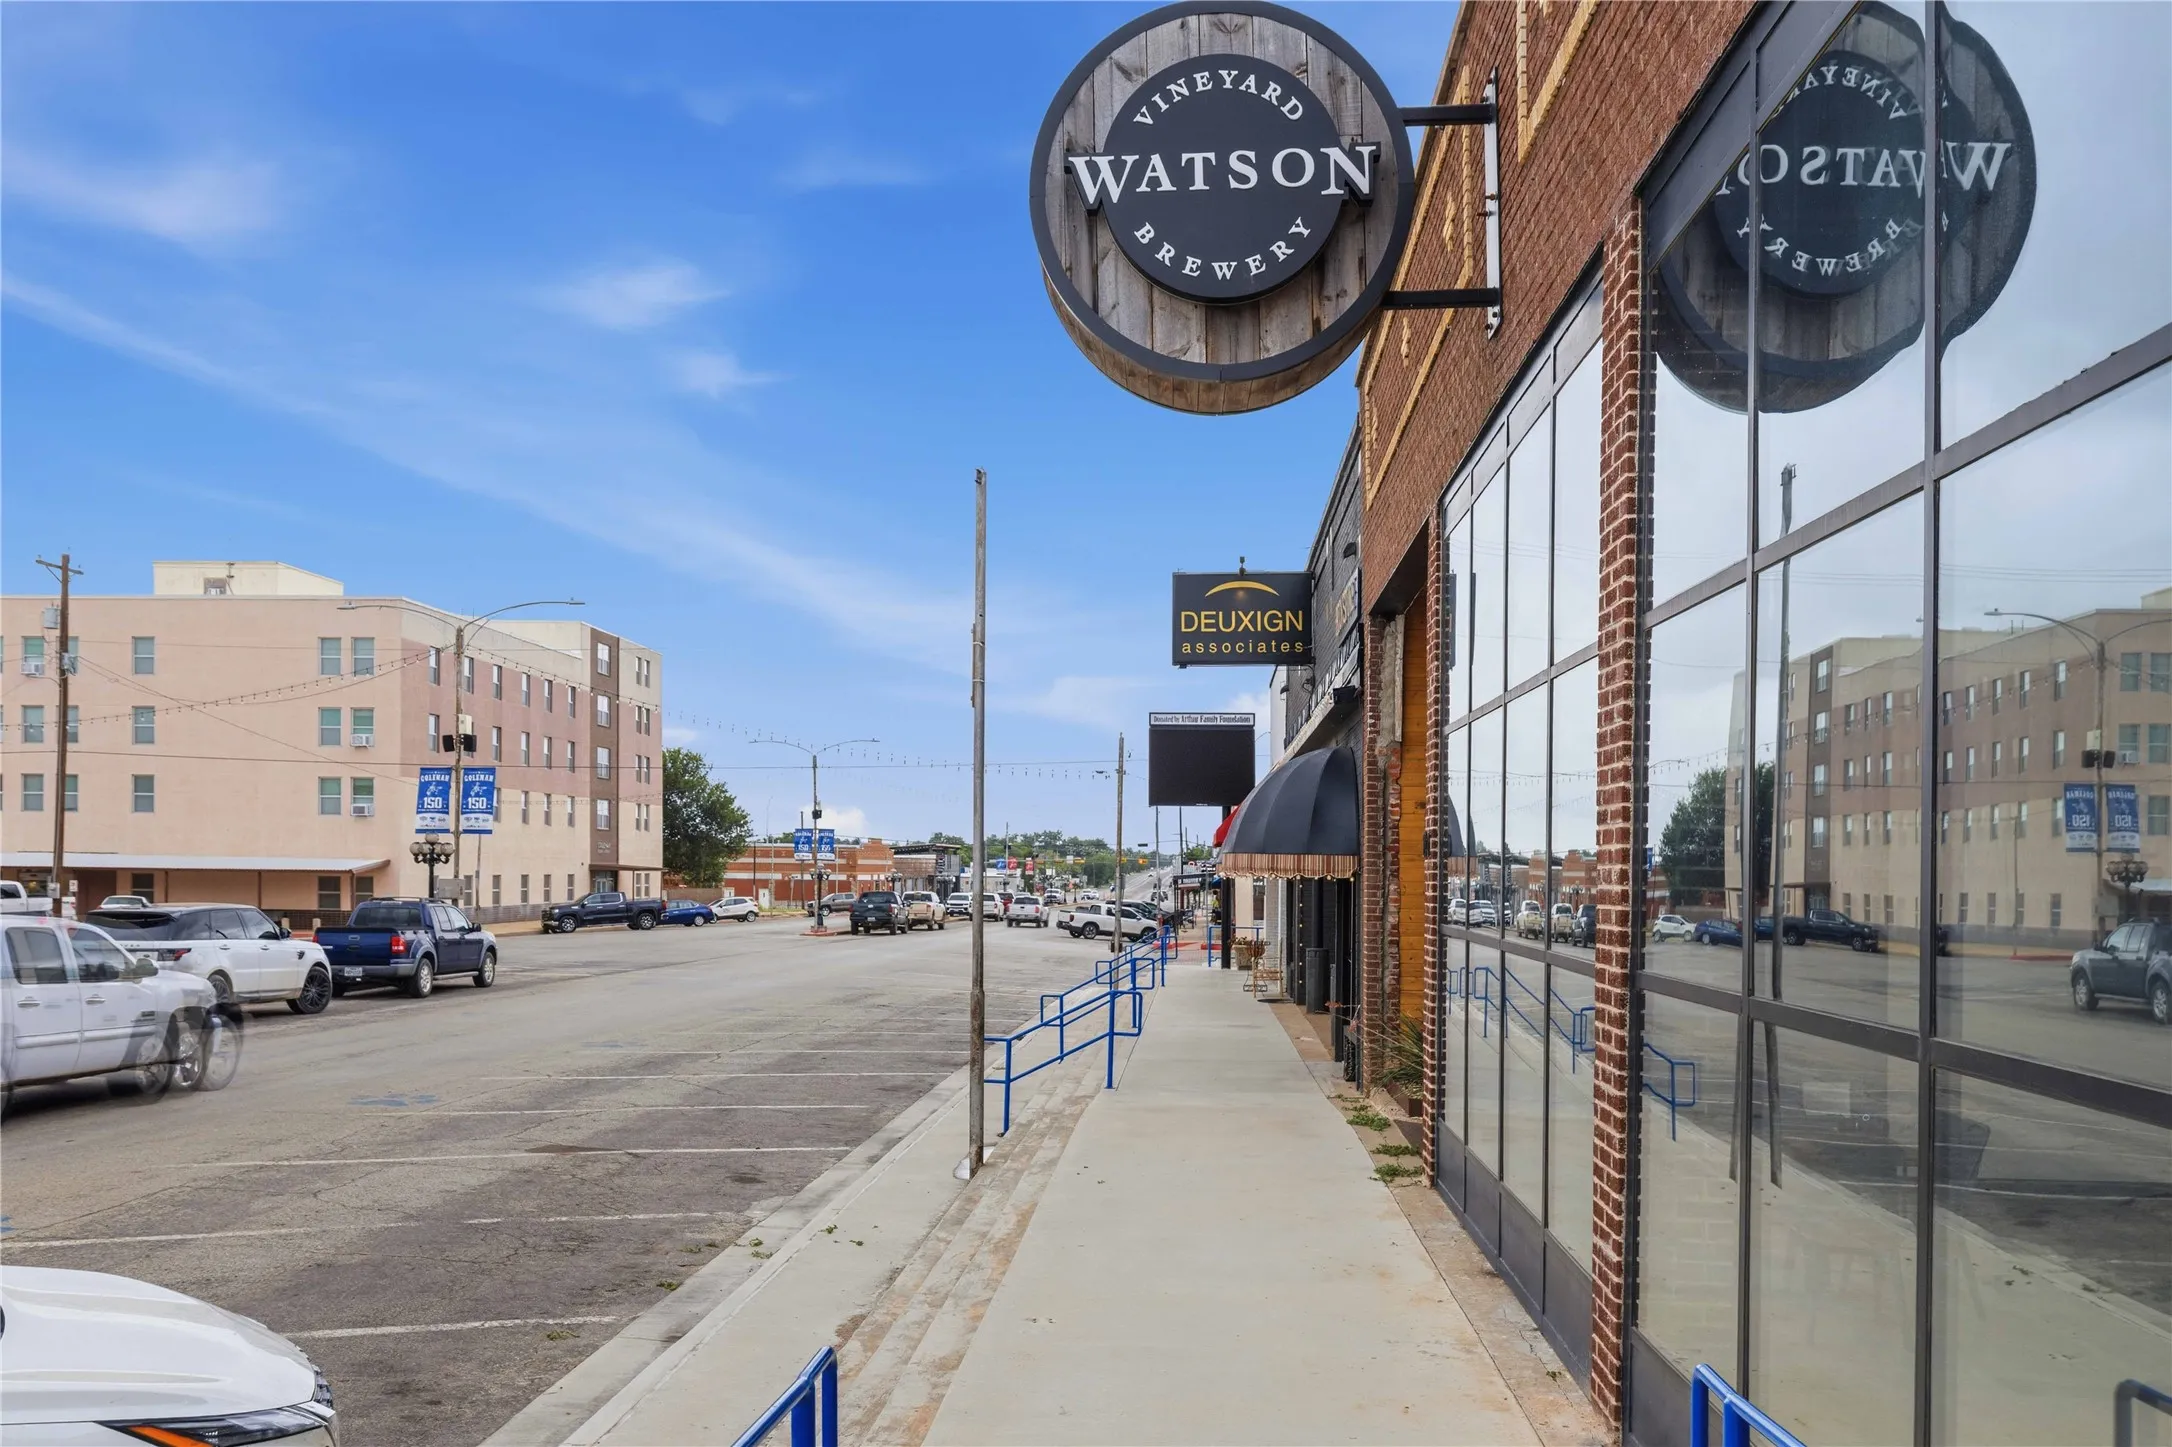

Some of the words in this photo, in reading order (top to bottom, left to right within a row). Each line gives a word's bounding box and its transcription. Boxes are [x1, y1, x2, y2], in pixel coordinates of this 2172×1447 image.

[1133, 70, 1304, 126] VINEYARD
[1068, 144, 1377, 204] WATSON
[1134, 216, 1312, 281] BREWERY
[1180, 610, 1303, 632] DEUXIGN
[1182, 639, 1303, 653] associates
[423, 797, 443, 809] 150
[467, 797, 487, 809] 150
